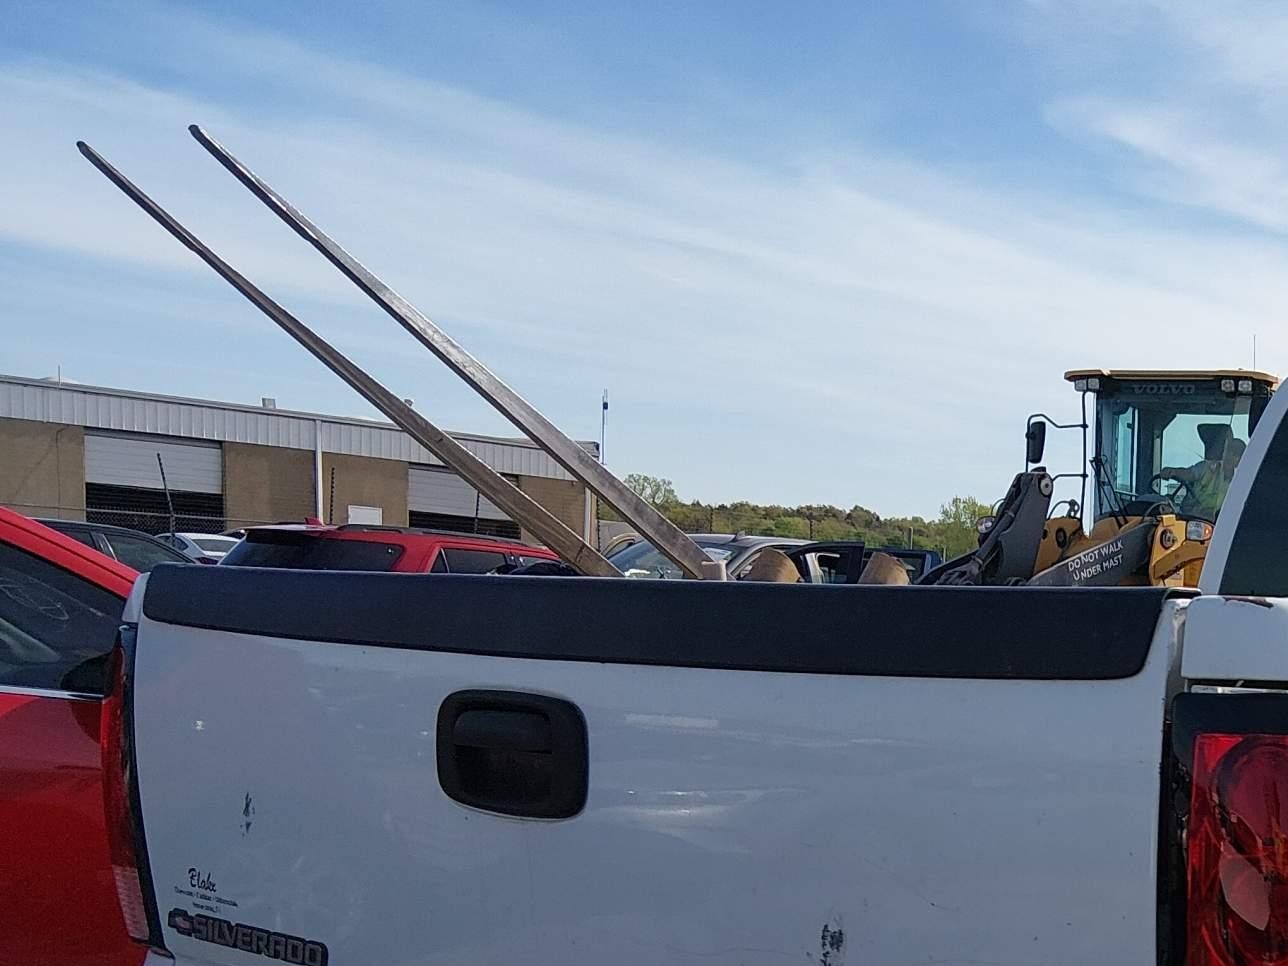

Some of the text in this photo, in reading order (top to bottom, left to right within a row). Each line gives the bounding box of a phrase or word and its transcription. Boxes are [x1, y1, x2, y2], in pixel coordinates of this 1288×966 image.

[1132, 384, 1196, 395] VOLVO
[1068, 540, 1124, 572] DO NOT WALK
[1073, 554, 1123, 581] UNDER MAST
